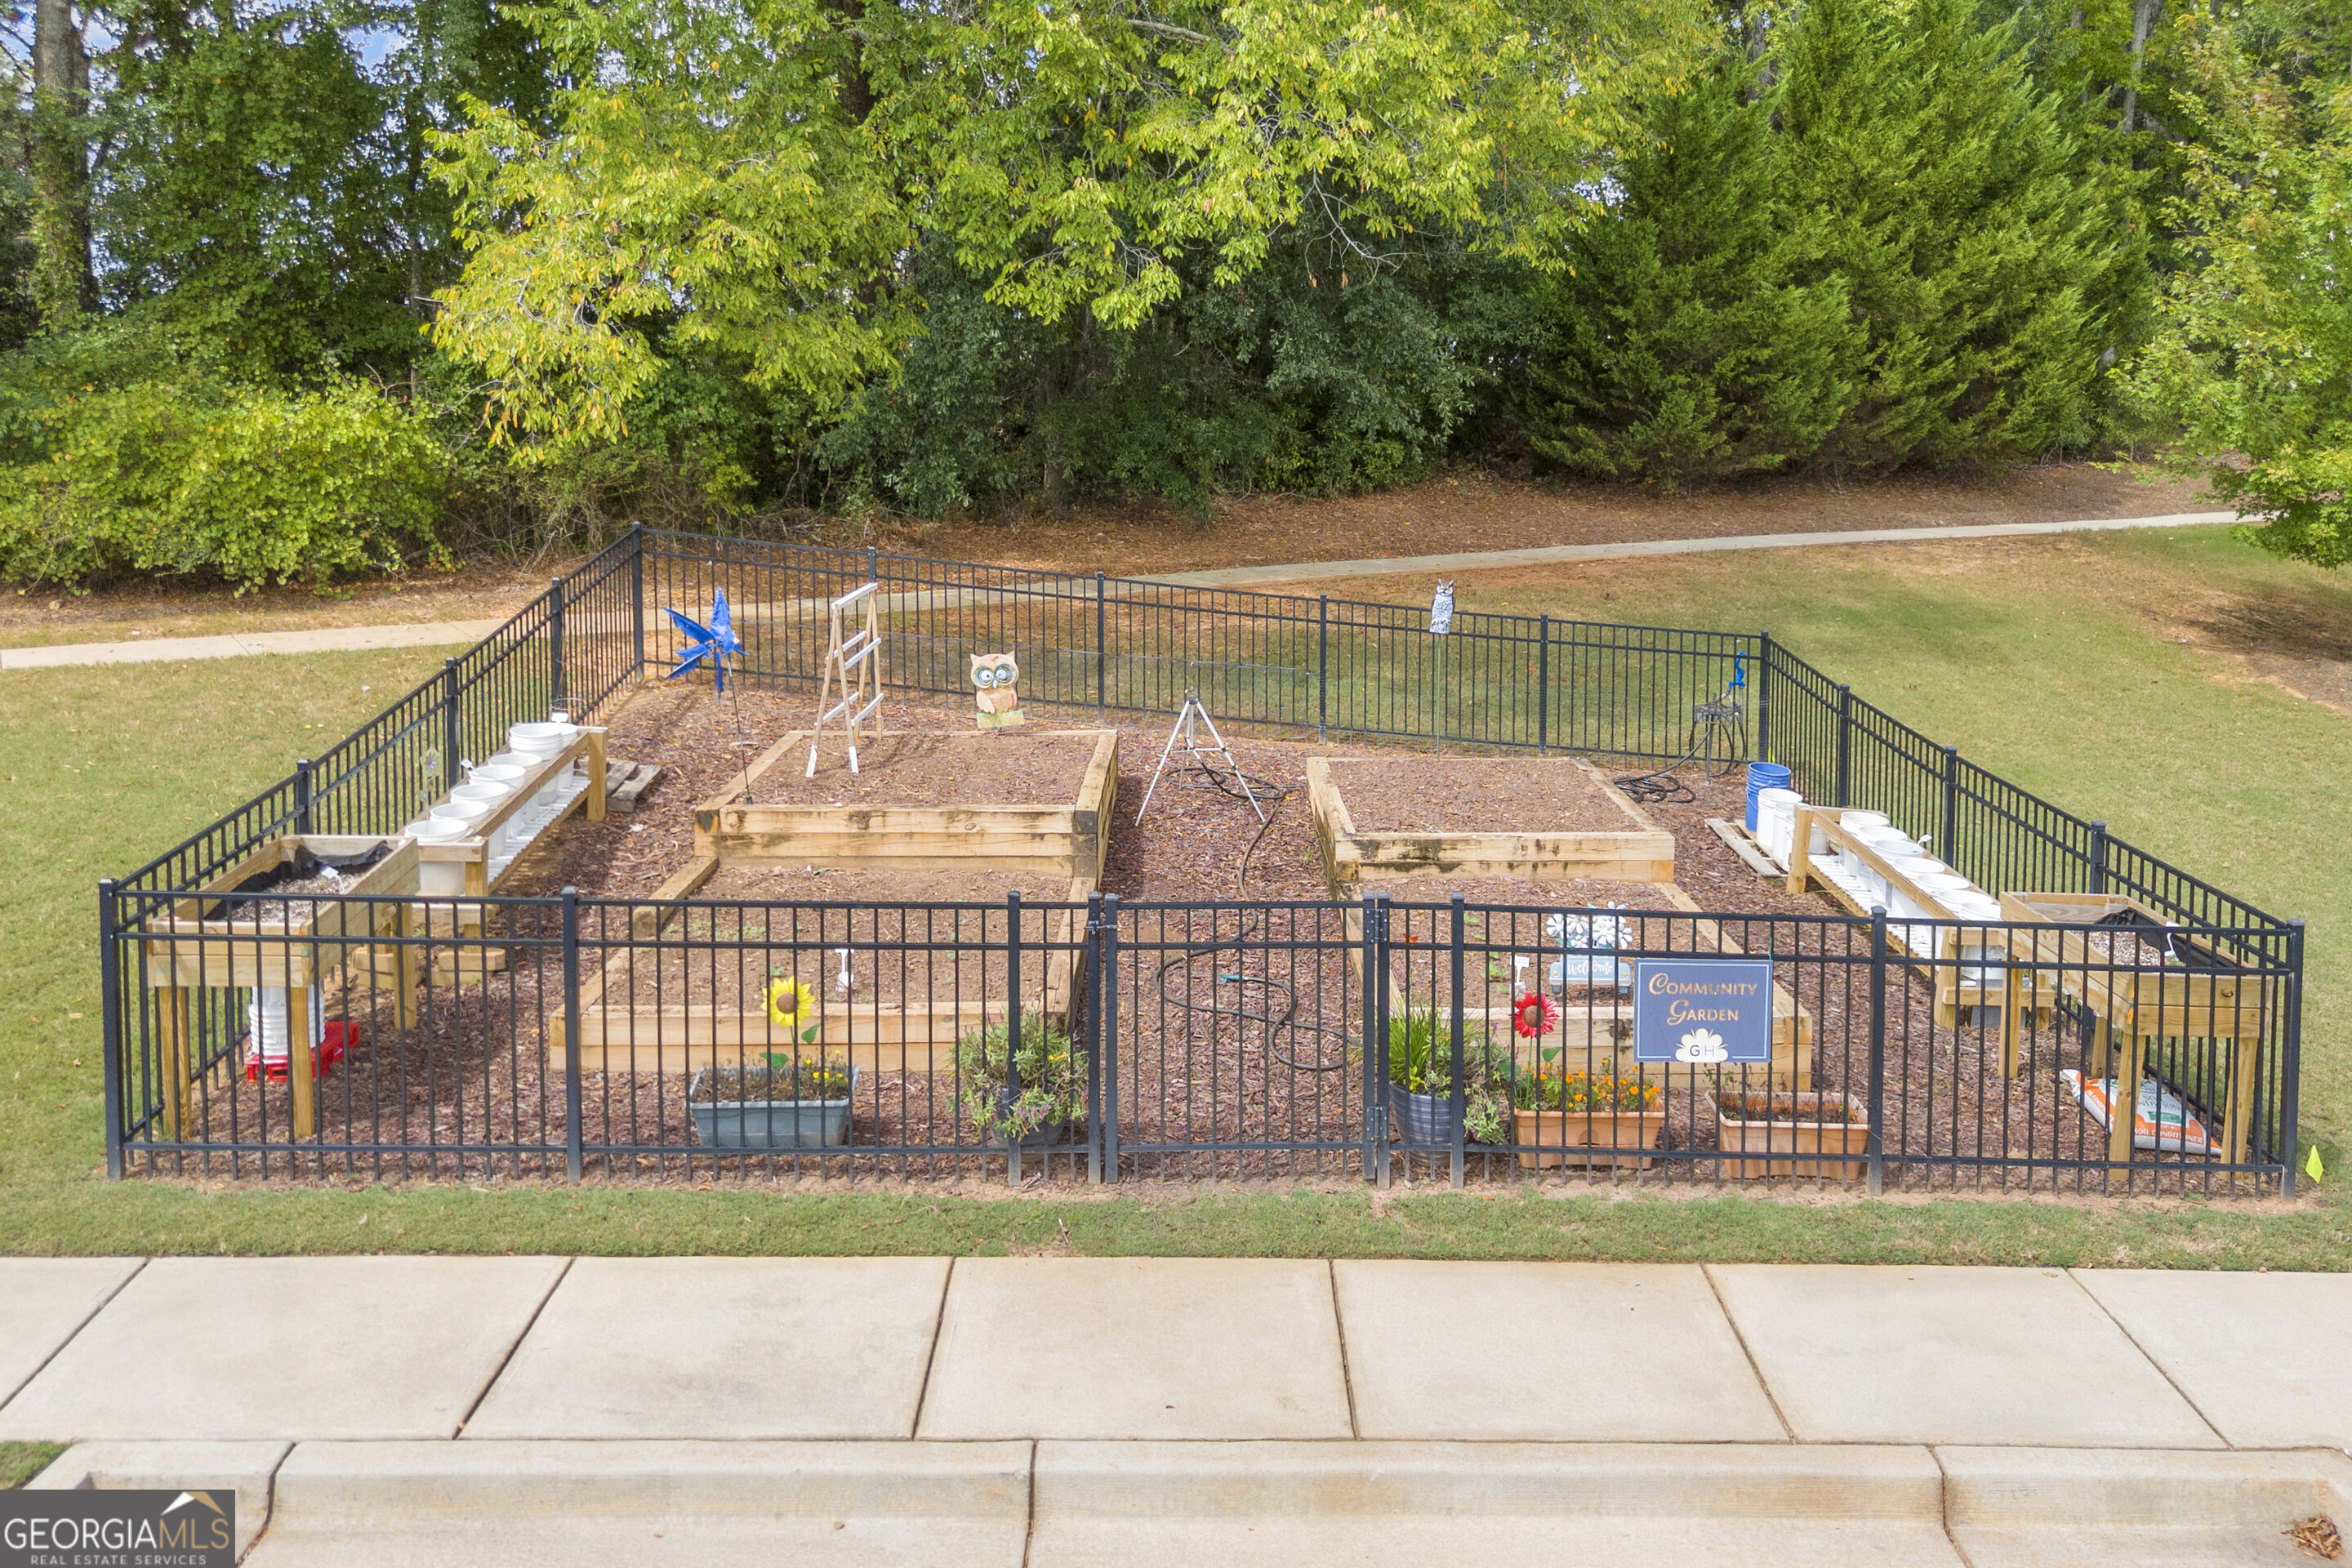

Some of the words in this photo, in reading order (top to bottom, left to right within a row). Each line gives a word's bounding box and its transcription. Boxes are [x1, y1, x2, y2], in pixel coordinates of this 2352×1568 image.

[1567, 960, 1615, 975] welome
[1648, 973, 1757, 996] COMMUNITY
[1667, 999, 1739, 1026] GARDEN
